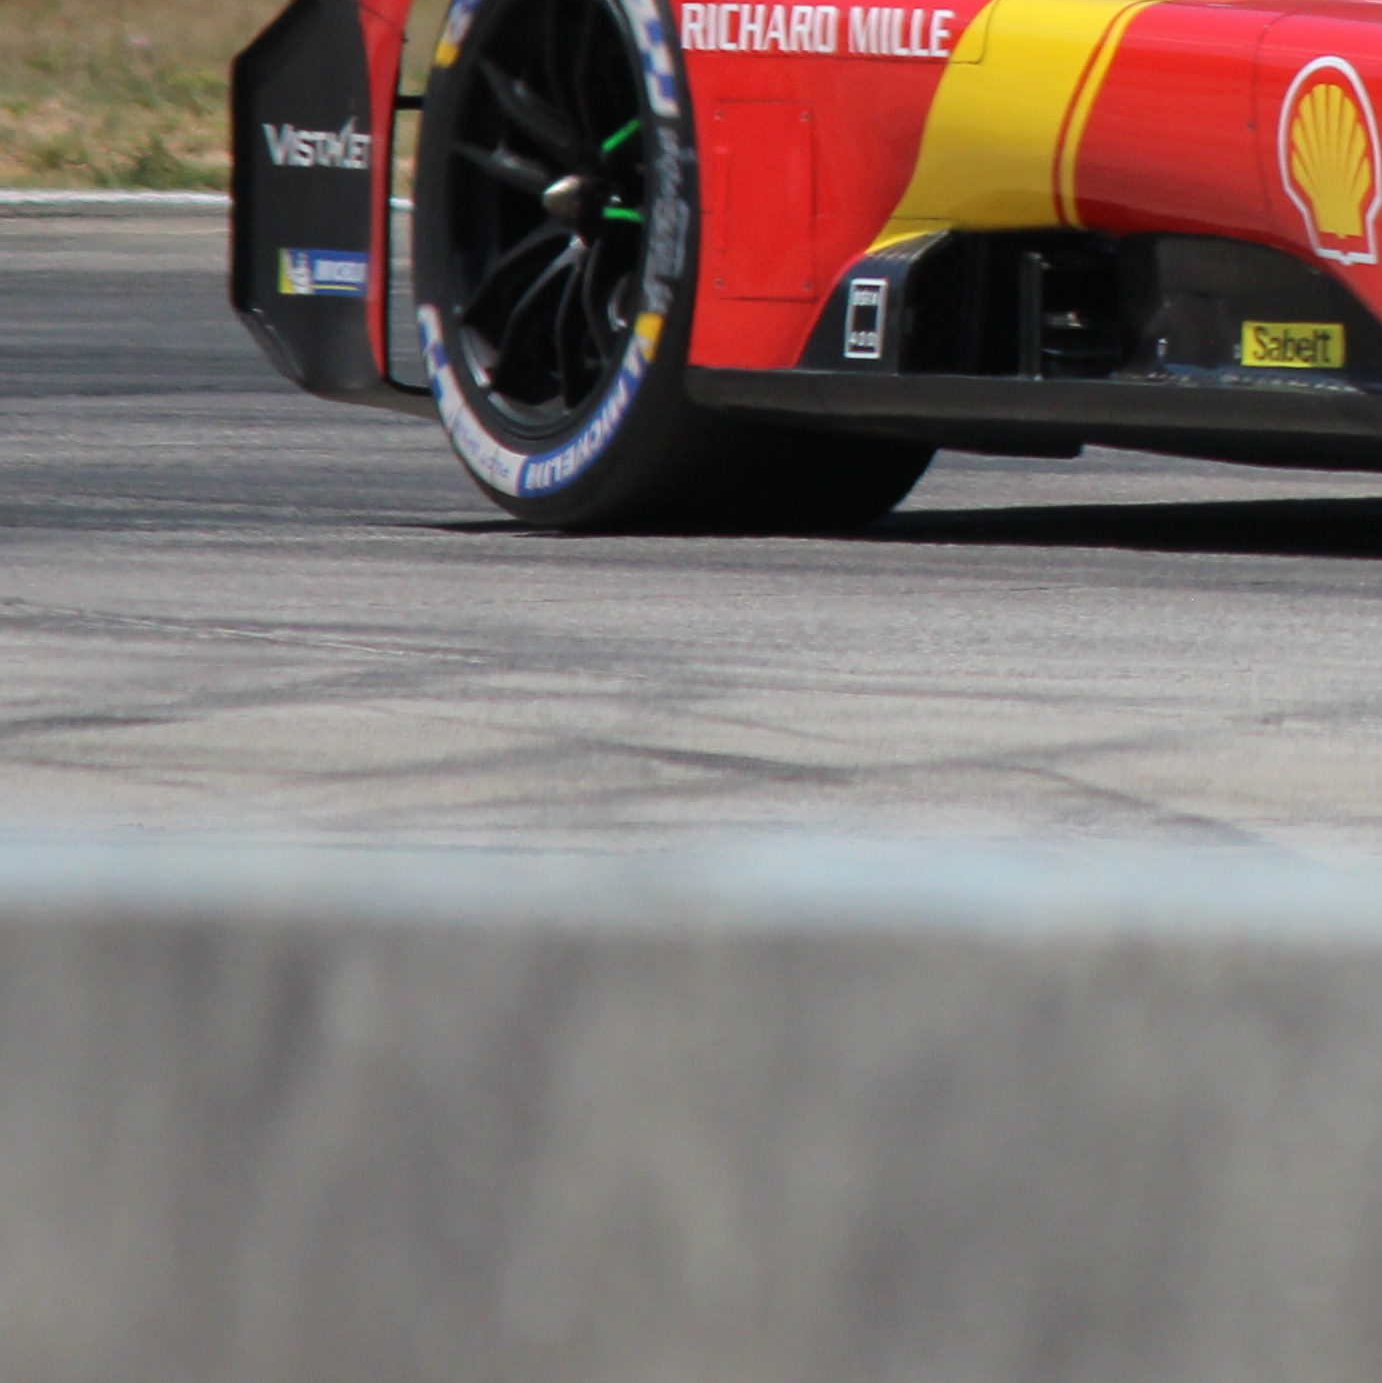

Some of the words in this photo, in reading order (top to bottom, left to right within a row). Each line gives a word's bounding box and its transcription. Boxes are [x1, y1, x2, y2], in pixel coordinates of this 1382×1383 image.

[681, 2, 840, 53] RICHARD
[849, 6, 956, 58] MILLE
[1252, 326, 1330, 363] Sabelt
